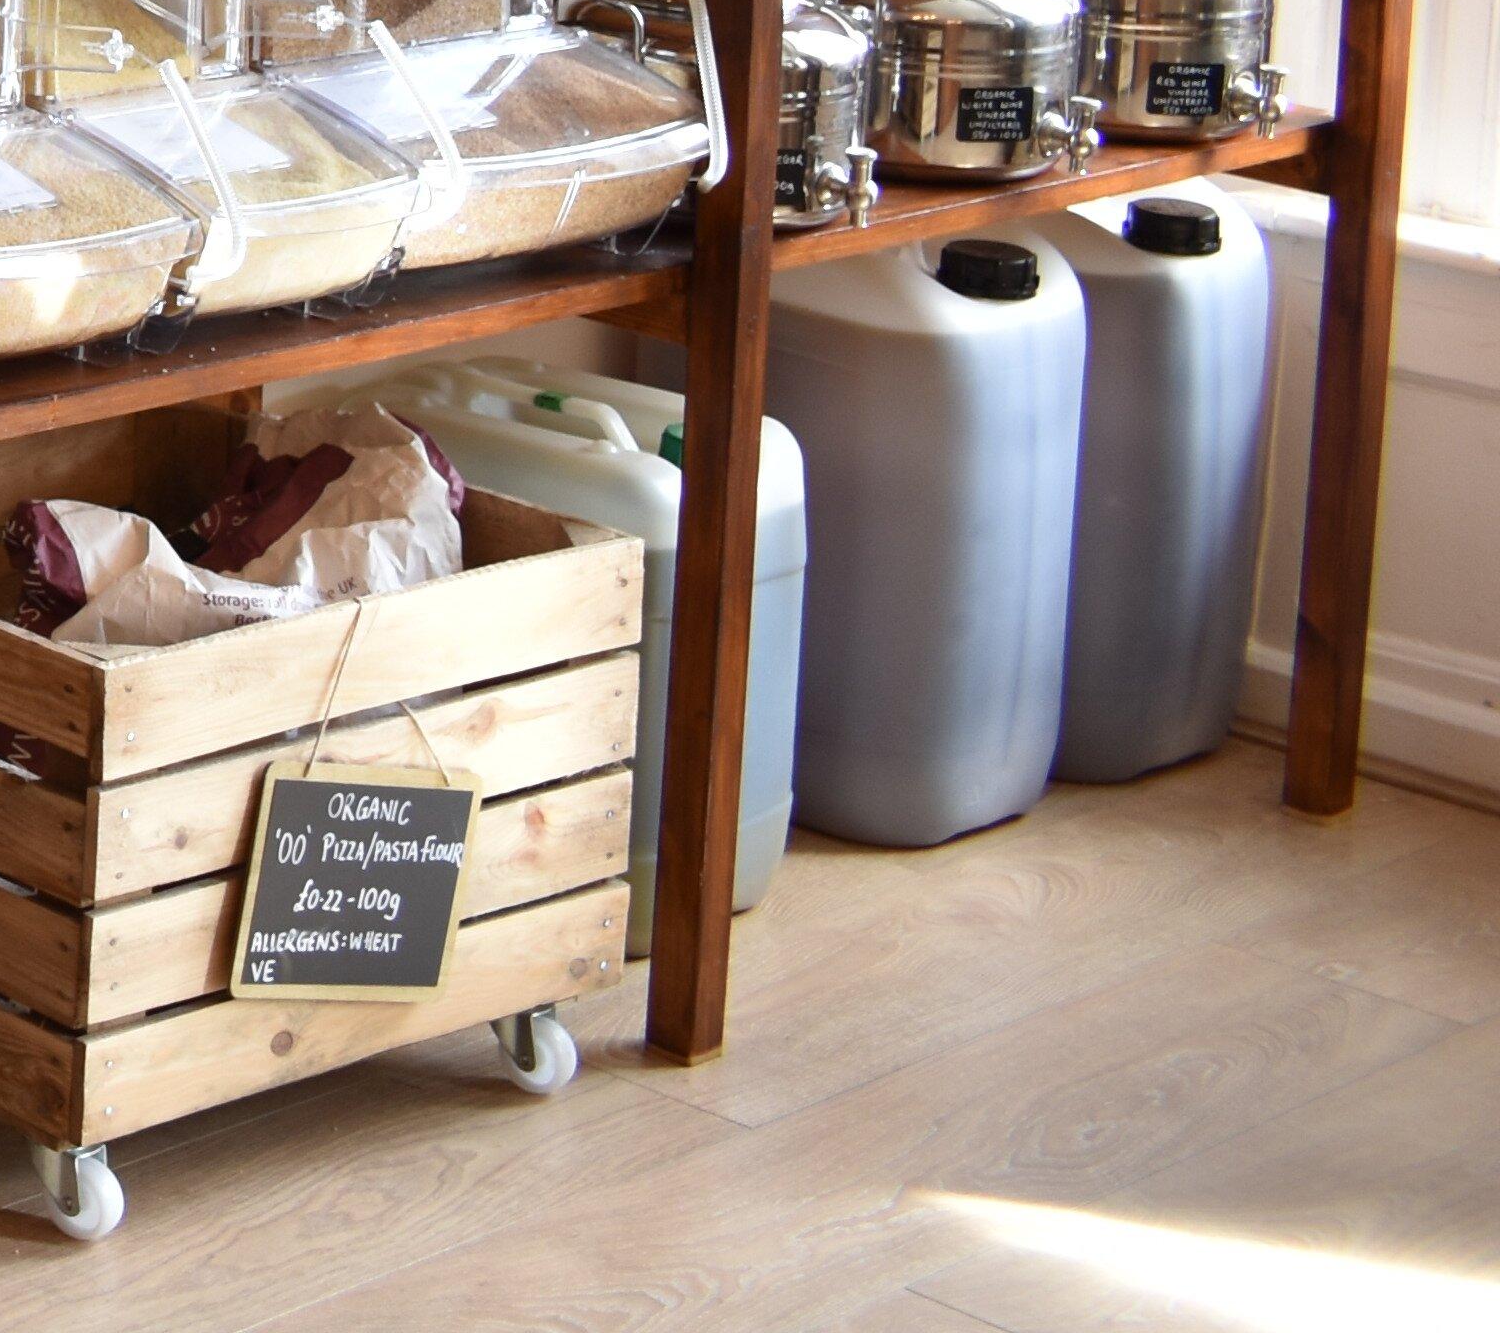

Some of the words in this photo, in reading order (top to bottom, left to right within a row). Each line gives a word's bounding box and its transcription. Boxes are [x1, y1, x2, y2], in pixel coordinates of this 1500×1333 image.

[338, 575, 358, 595] UK
[202, 592, 265, 612] Storage:
[327, 791, 413, 826] ORGANIC
[250, 959, 278, 983] VE
